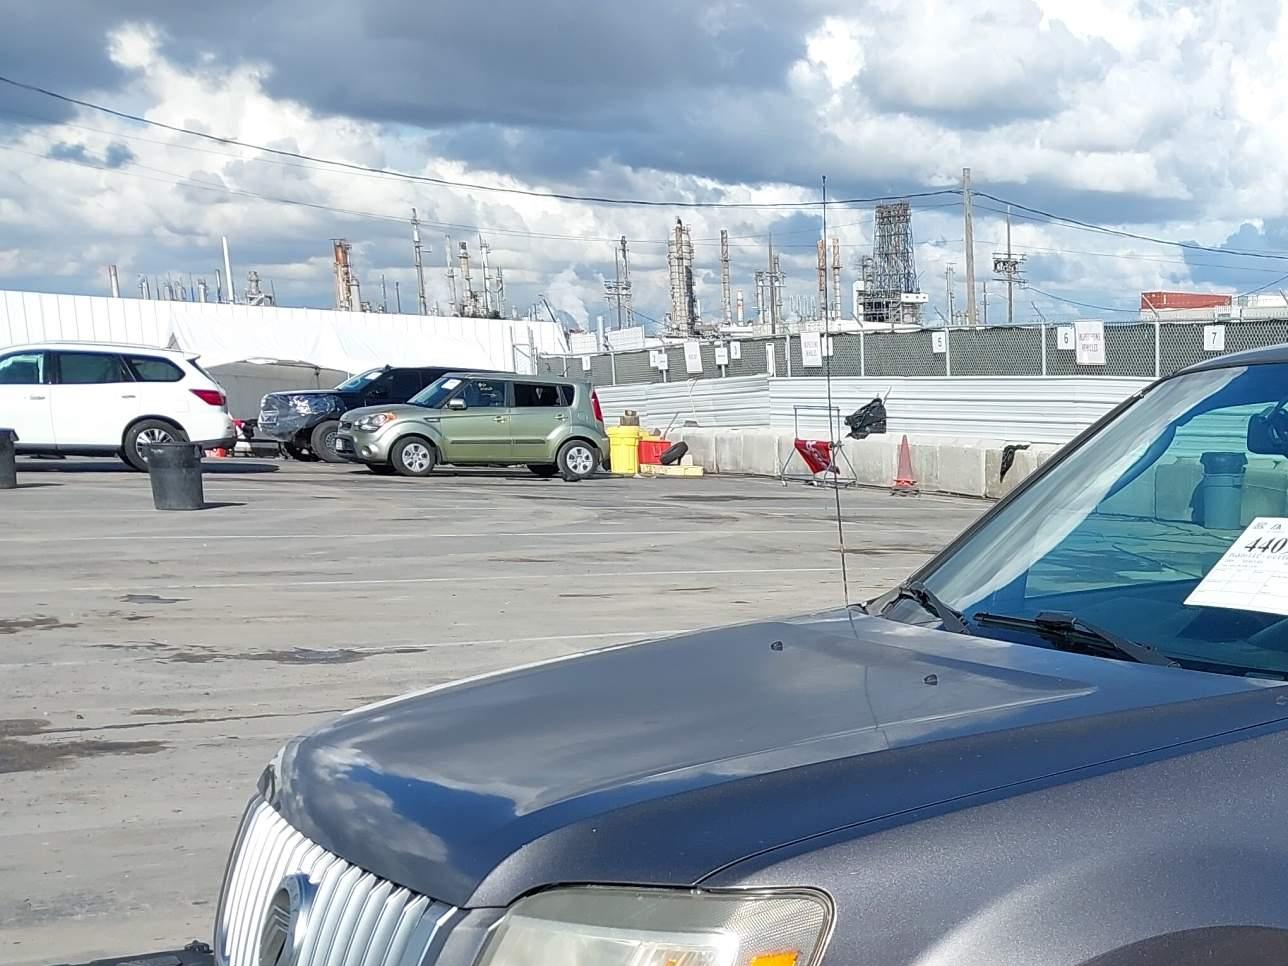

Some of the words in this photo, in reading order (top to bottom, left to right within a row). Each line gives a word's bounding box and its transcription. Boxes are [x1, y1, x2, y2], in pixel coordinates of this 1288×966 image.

[937, 337, 942, 348] 5
[1063, 332, 1069, 344] 6
[1211, 332, 1217, 345] 7
